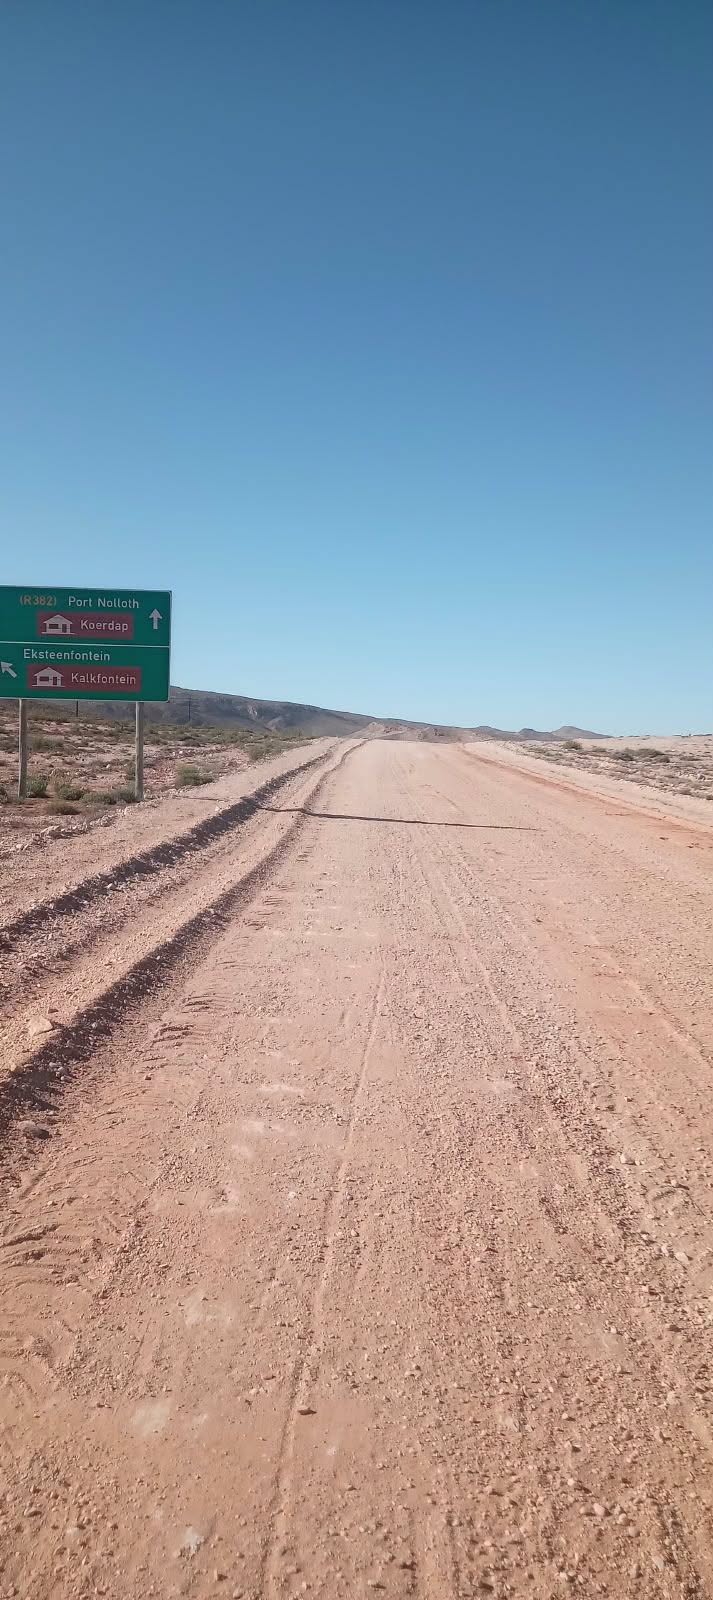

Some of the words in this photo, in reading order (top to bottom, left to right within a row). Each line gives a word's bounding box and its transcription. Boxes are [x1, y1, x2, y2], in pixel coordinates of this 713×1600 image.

[20, 594, 57, 607] (R382)
[68, 596, 93, 608] Port
[97, 598, 140, 609] Nolloth
[80, 619, 129, 632] Koerdap
[23, 648, 111, 661] Eksteenfontein
[71, 672, 137, 685] Kalkfontein
